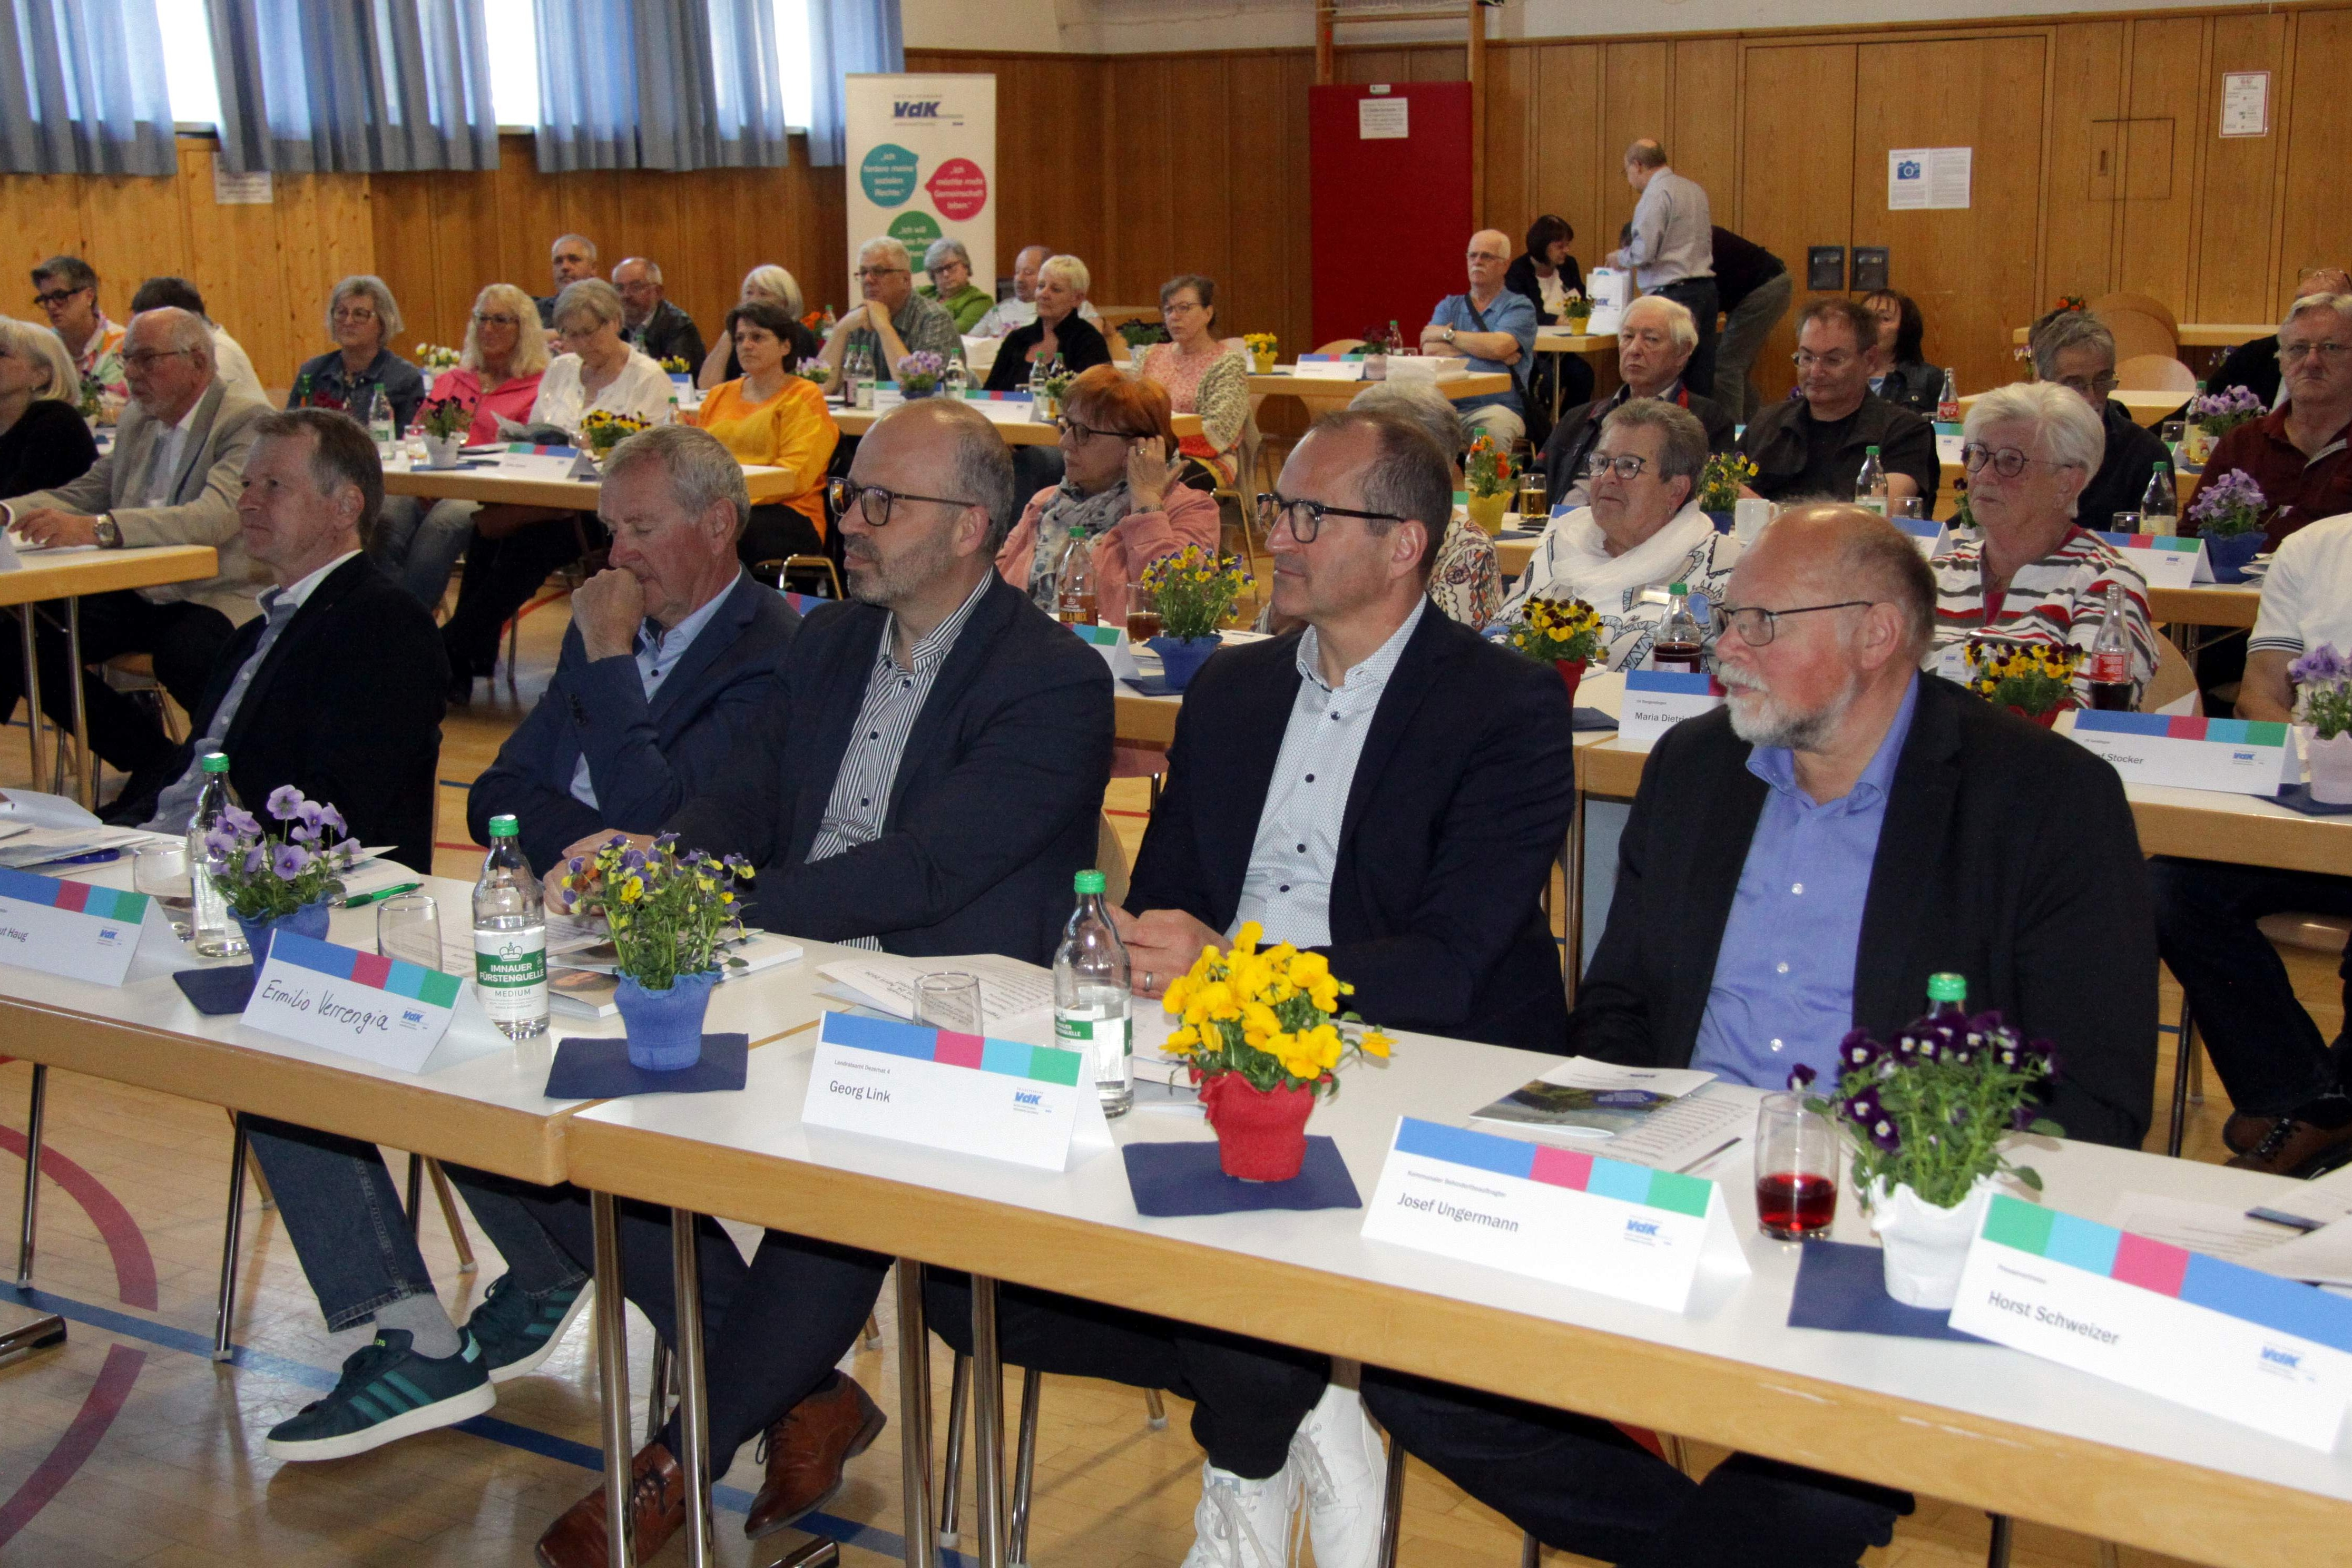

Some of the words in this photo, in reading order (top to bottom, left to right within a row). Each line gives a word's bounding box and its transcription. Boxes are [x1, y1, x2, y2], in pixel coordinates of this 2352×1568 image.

[894, 101, 940, 117] VdK
[1635, 712, 1659, 721] Maria
[2107, 753, 2144, 764] Stocker
[7, 927, 29, 942] Haug
[479, 968, 544, 982] FÜRSTENQUELLE
[491, 963, 532, 973] IMNAUER
[495, 988, 531, 997] MEDIUM
[262, 980, 310, 1011] Ermilio
[318, 990, 388, 1034] Verrengia
[834, 1060, 864, 1070] Landratsamt
[830, 1080, 864, 1100] Georg
[866, 1086, 891, 1103] Link
[1015, 1092, 1042, 1105] VdK
[1397, 1193, 1435, 1212] Josef
[1437, 1201, 1520, 1232] Ungermann
[1627, 1219, 1660, 1236] VdK
[1988, 1290, 2031, 1317] Horst
[2035, 1305, 2119, 1345] Schweizer
